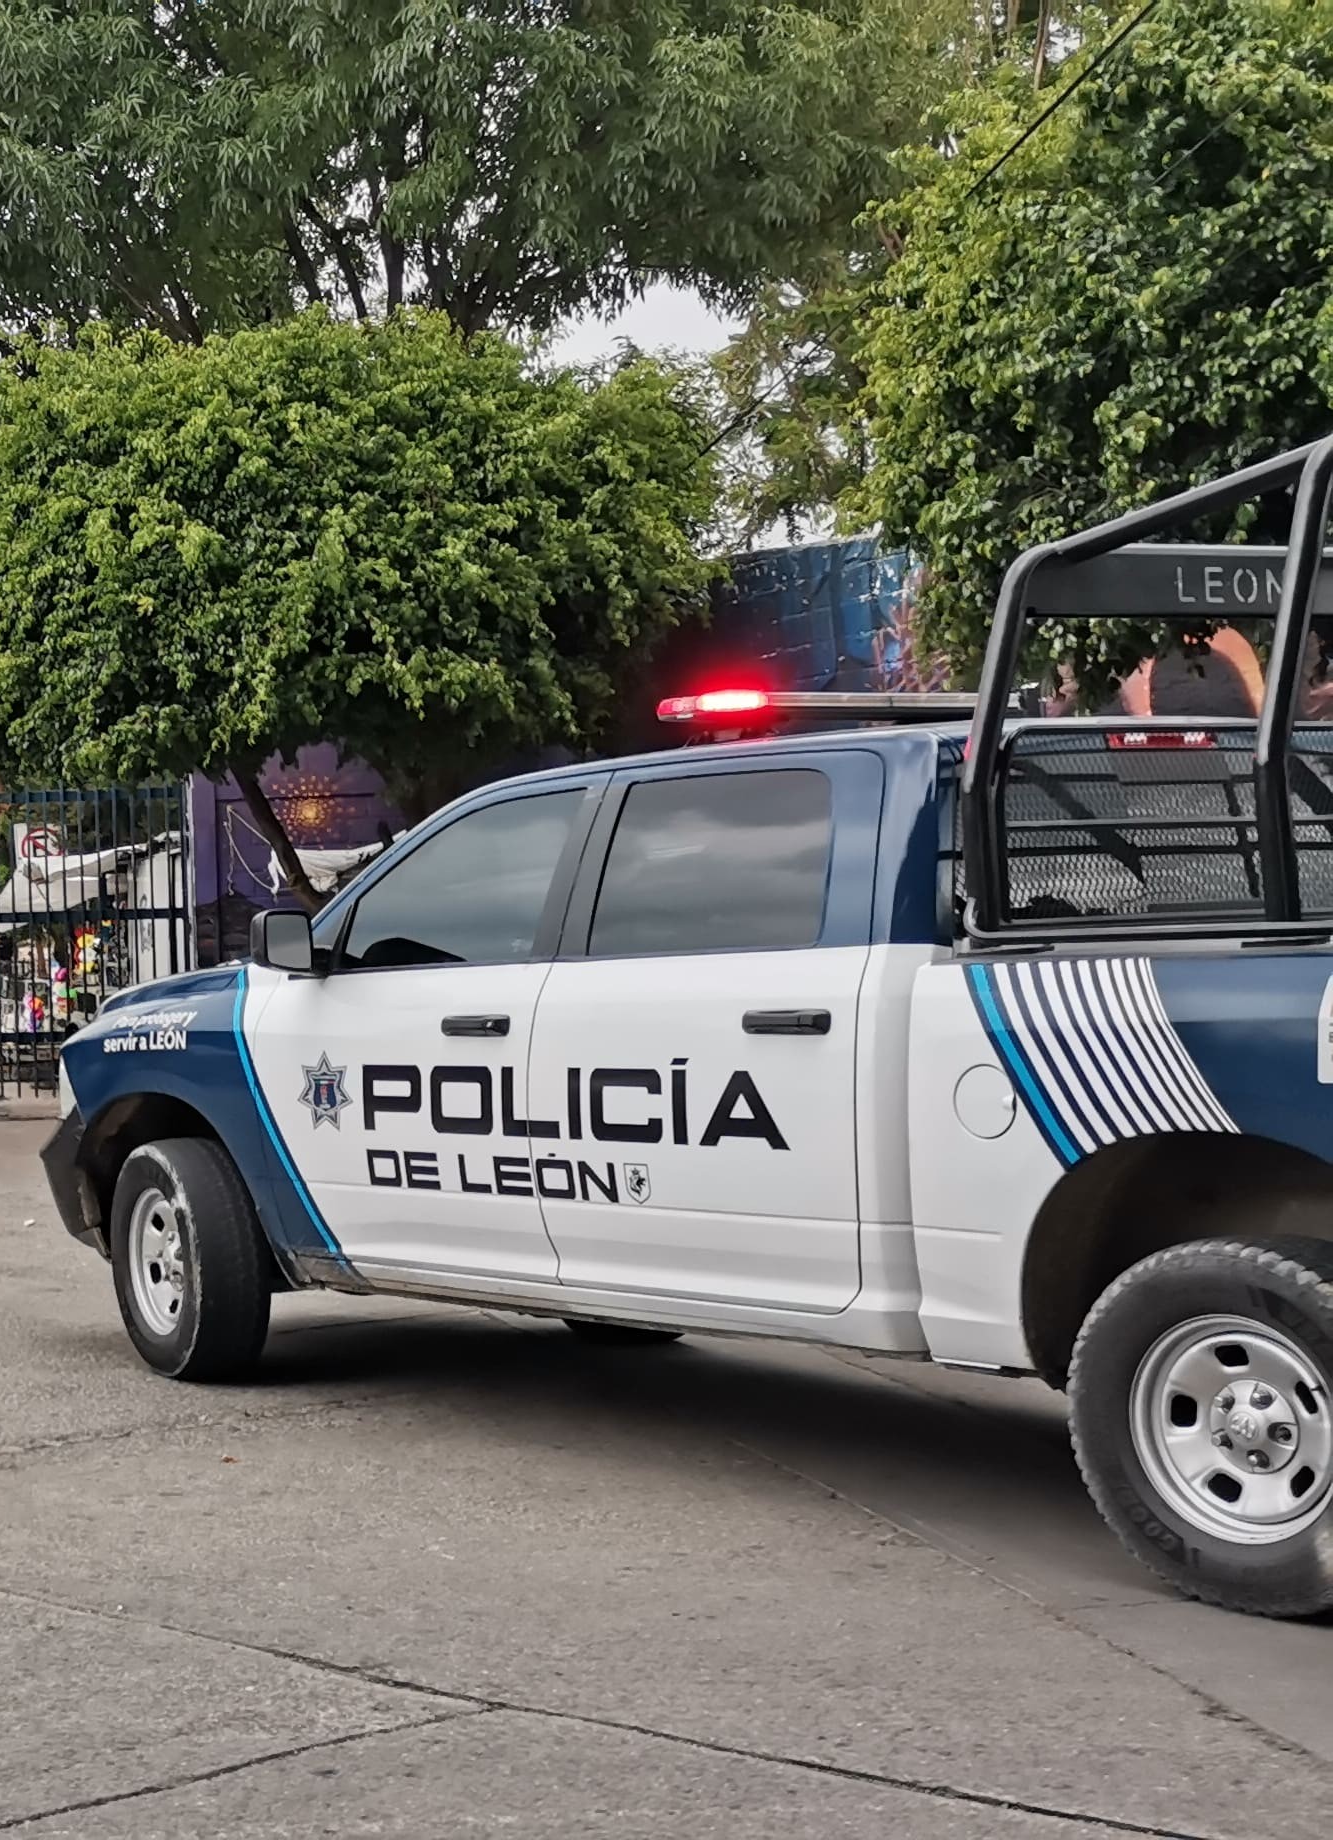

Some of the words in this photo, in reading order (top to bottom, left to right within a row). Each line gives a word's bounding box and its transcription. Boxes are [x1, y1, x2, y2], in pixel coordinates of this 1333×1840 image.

[103, 1031, 138, 1053] servir
[139, 1036, 148, 1051] a
[149, 1027, 187, 1051] LEÓN
[362, 1057, 791, 1151] POLICÍA
[366, 1148, 442, 1191] DE
[458, 1152, 620, 1204] LEÓN
